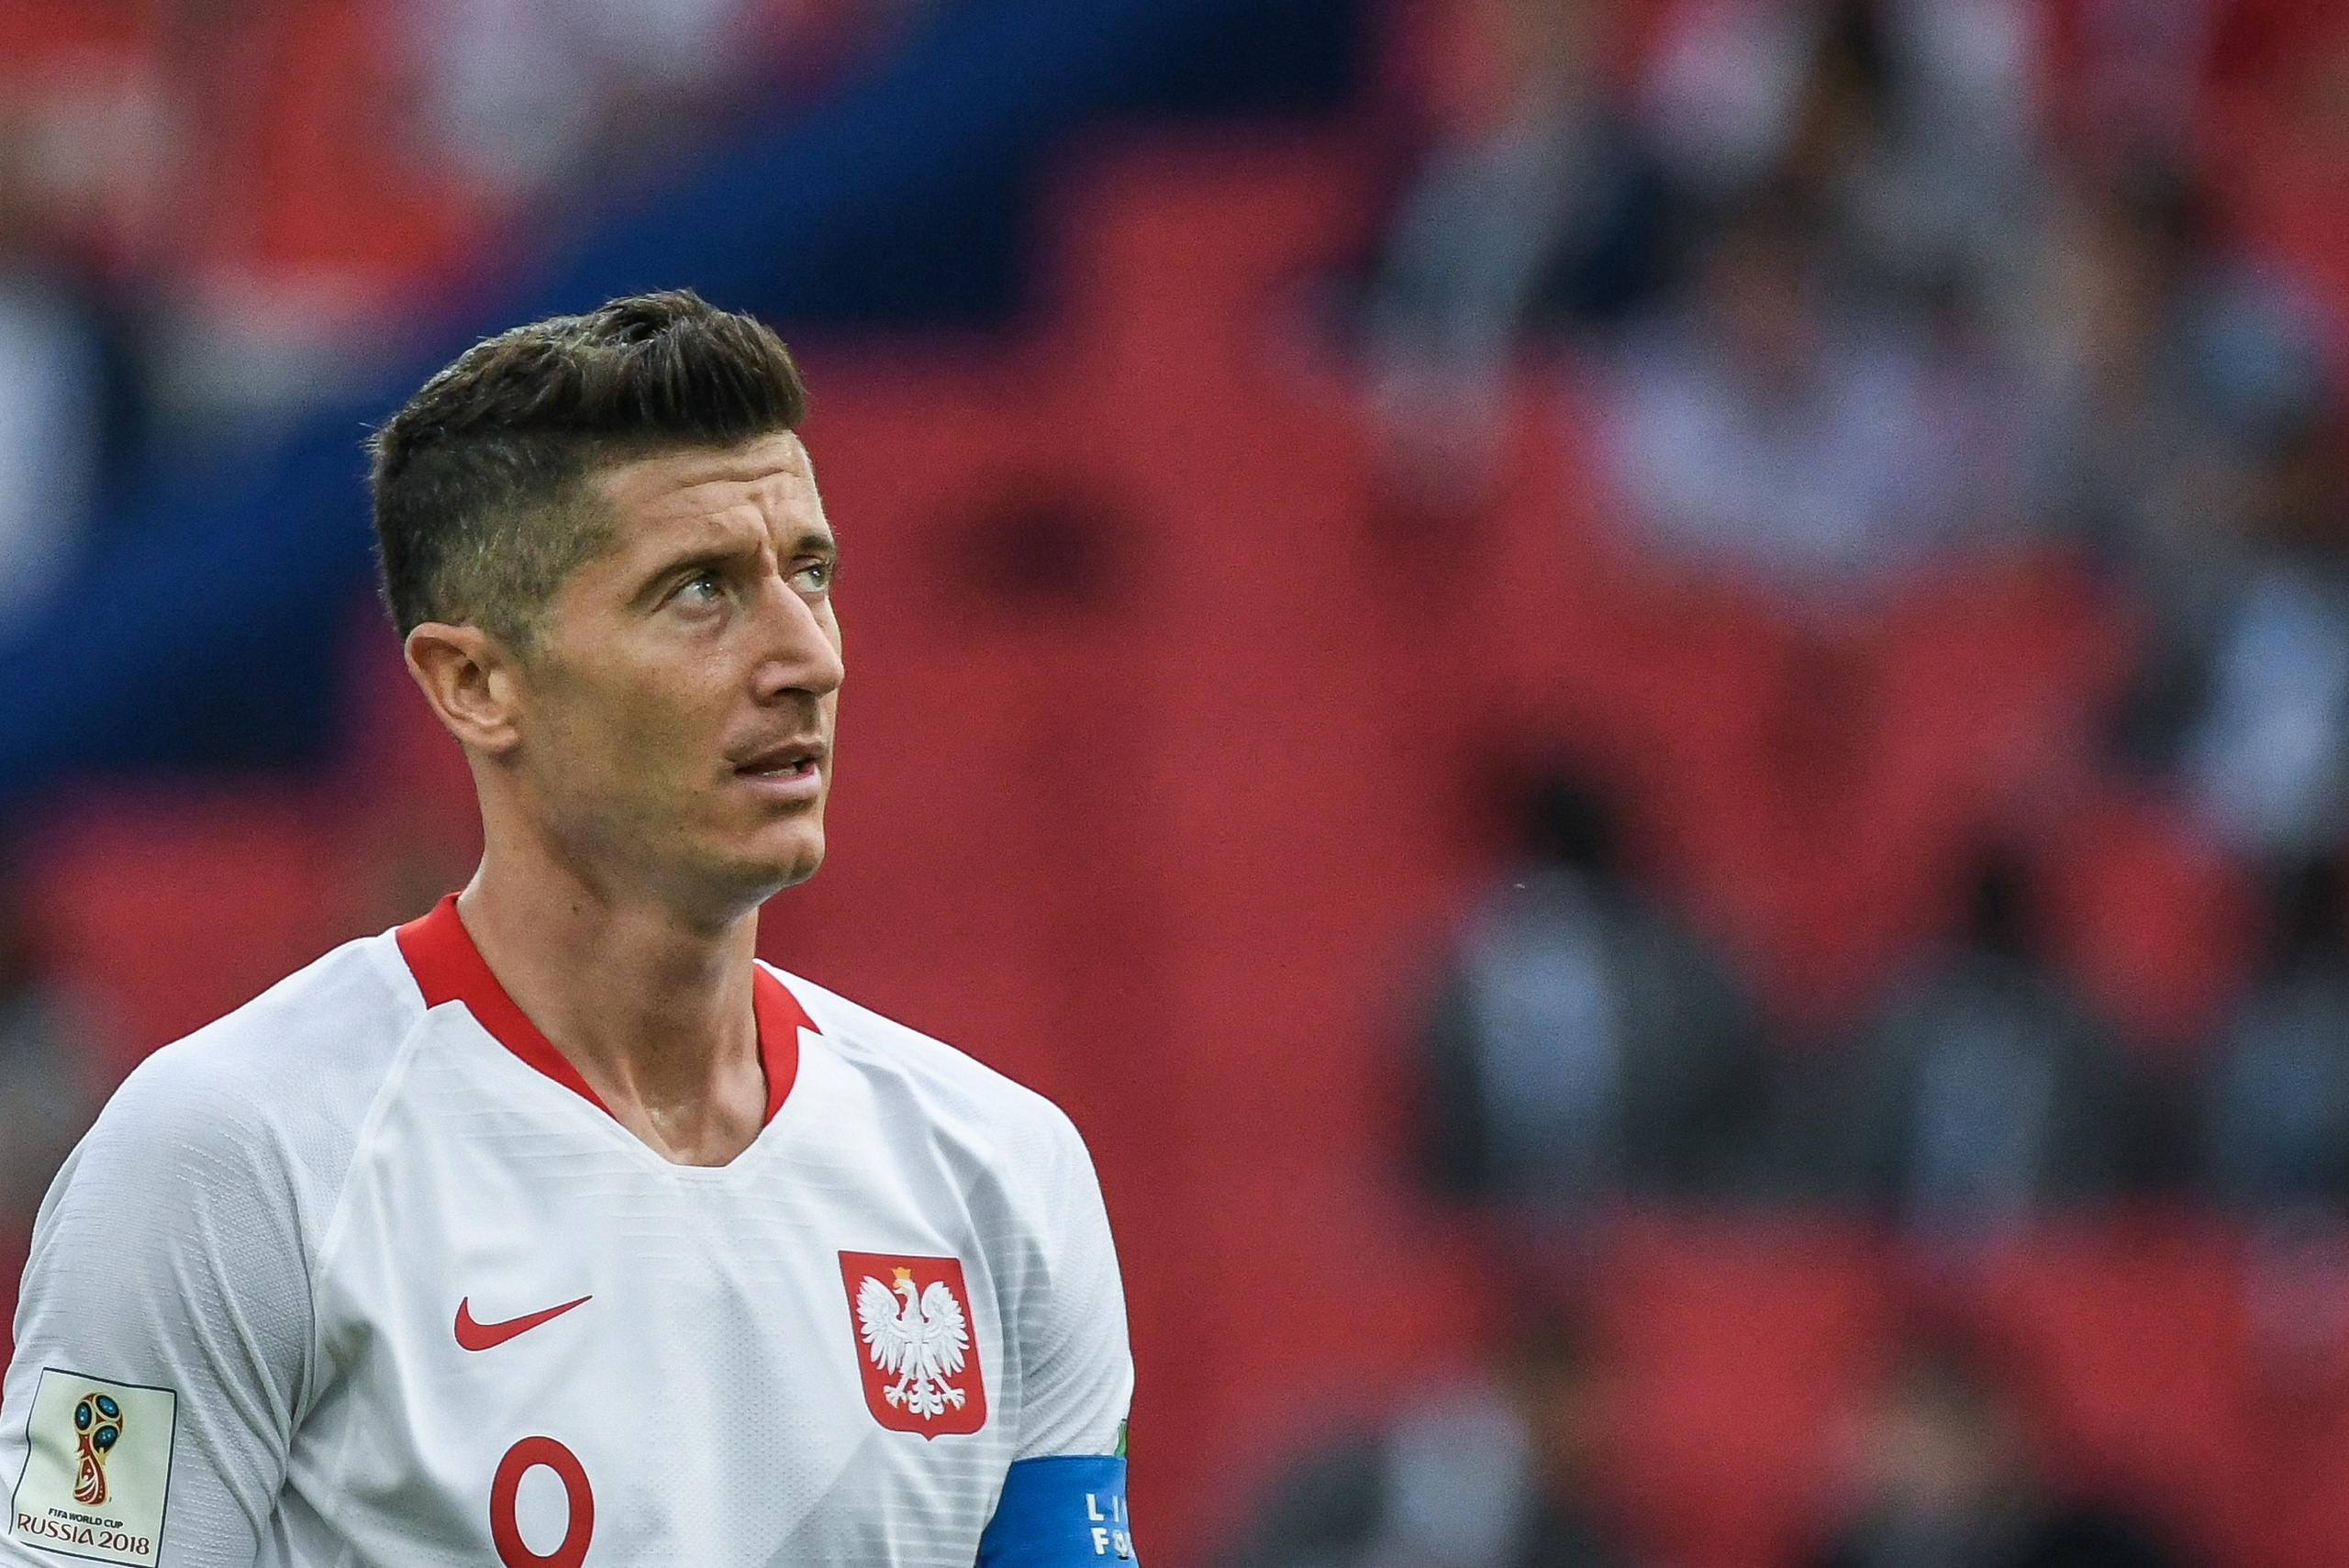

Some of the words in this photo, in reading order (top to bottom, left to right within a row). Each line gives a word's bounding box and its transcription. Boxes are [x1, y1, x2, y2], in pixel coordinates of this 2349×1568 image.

[49, 1507, 68, 1519] FIFA
[69, 1512, 102, 1526] WORLD
[104, 1518, 124, 1529] CUP
[1085, 1494, 1128, 1522] LI
[17, 1513, 94, 1545] RUSSIA
[98, 1530, 150, 1555] 2018
